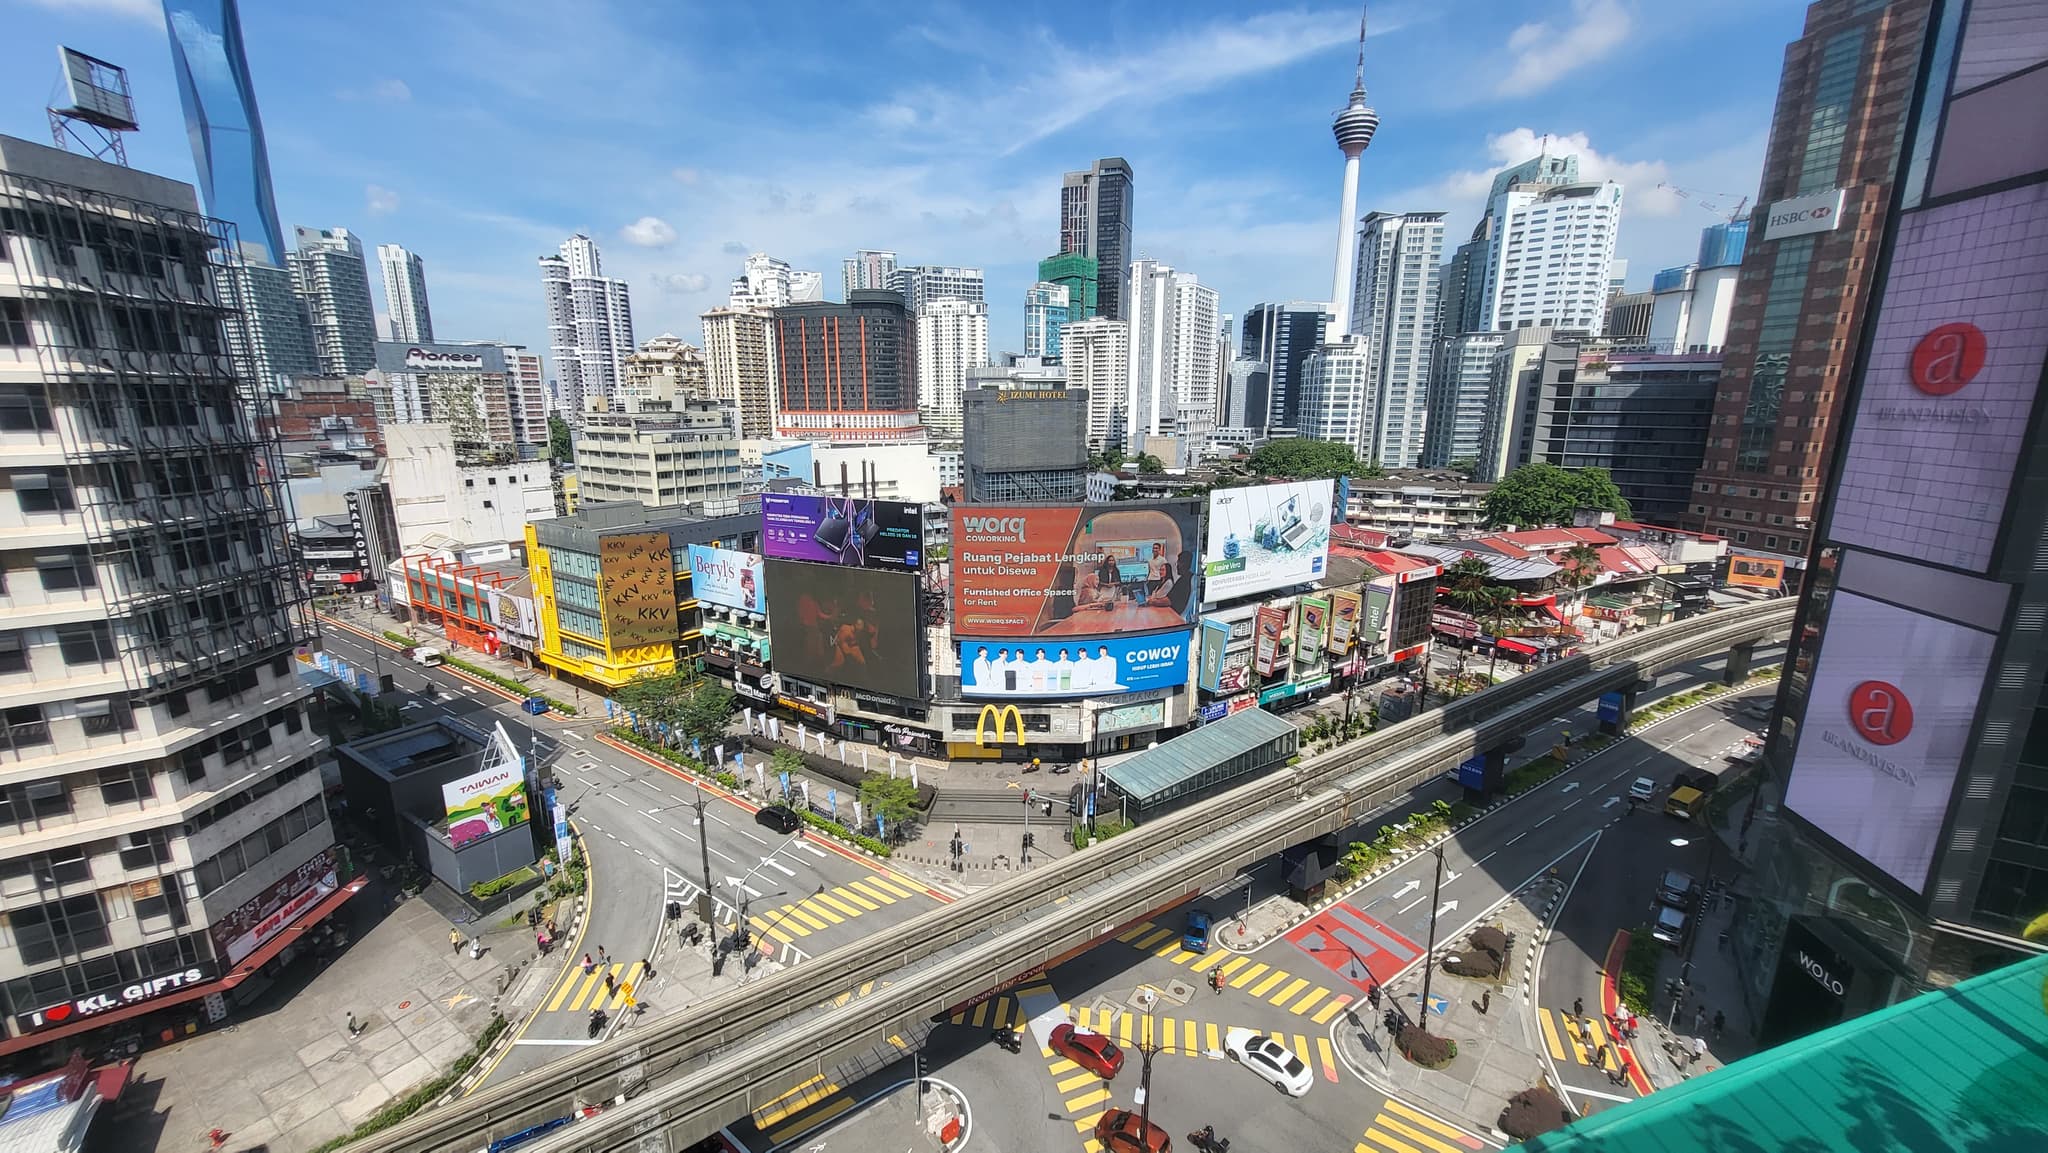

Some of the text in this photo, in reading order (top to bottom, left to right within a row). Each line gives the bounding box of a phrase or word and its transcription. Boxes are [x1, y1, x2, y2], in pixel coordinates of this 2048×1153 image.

[1770, 210, 1809, 227] HSBC
[406, 347, 482, 362] Pioneer
[1010, 391, 1068, 400] IZUMI HOTEL
[1216, 496, 1235, 505] acer
[903, 506, 918, 515] intel
[349, 503, 368, 567] KARAOKE
[963, 516, 1026, 543] worq
[607, 541, 626, 550] KKV
[627, 545, 644, 561] KKV
[963, 551, 1105, 565] Ruang Pejabat Lengkap
[696, 555, 735, 582] Beryl's
[963, 565, 1037, 576] untuk Disewa
[613, 584, 640, 607] KKV
[641, 593, 659, 602] KKV
[963, 587, 1077, 599] Furnished Office Spaces
[977, 598, 998, 607] Rent
[638, 607, 670, 620] KKV
[1370, 606, 1379, 628] intel
[622, 644, 665, 664] KKV
[1125, 644, 1181, 664] coway
[1207, 643, 1217, 673] acer
[855, 692, 896, 705] McDonald's
[460, 771, 509, 794] TAIWAN
[1800, 951, 1843, 995] WOLO
[31, 1012, 44, 1027] I
[76, 994, 117, 1014] KL
[122, 968, 202, 1000] GIFTS
[967, 986, 1000, 1006] Reach
